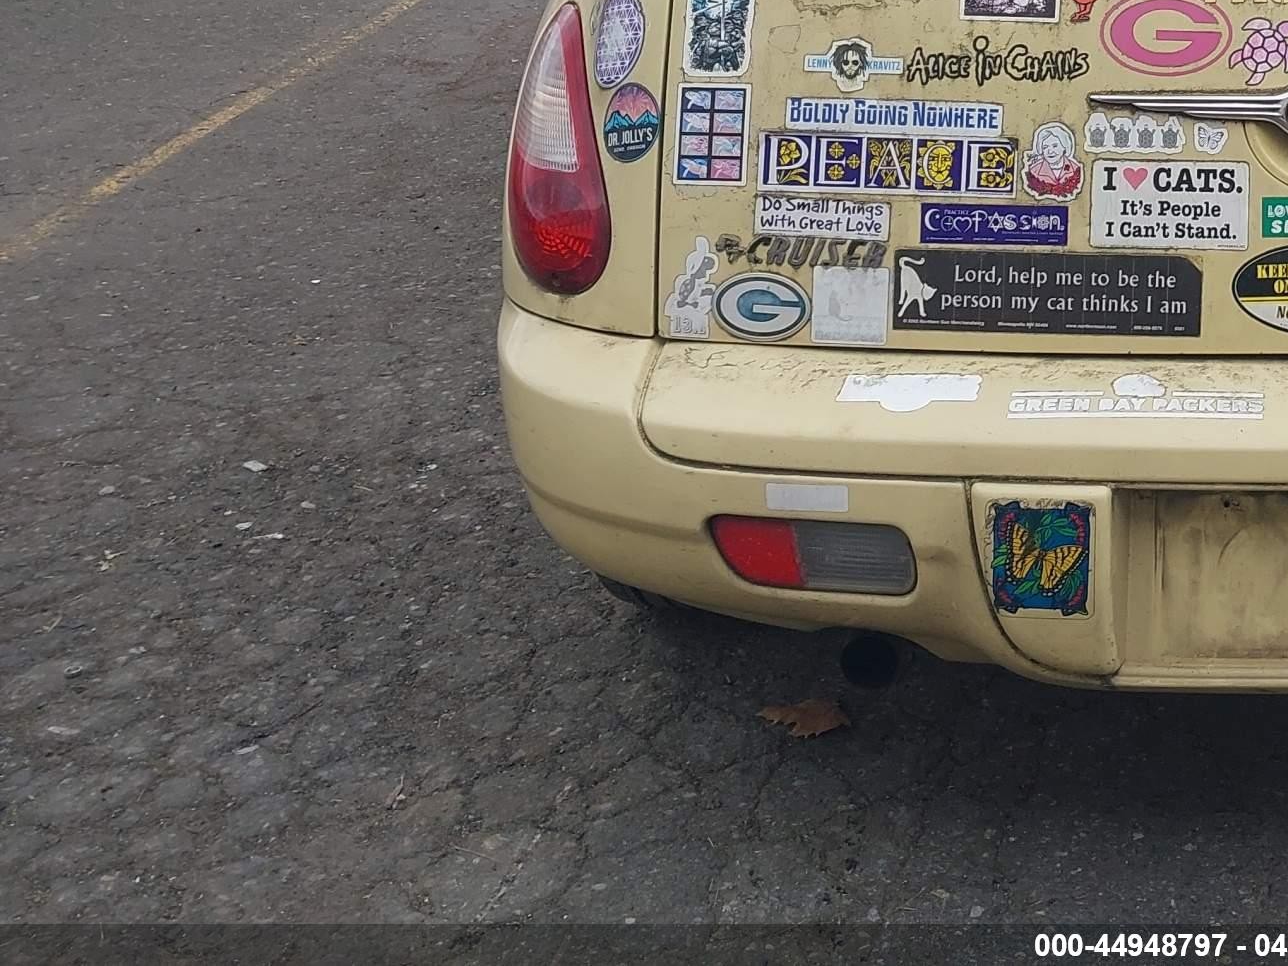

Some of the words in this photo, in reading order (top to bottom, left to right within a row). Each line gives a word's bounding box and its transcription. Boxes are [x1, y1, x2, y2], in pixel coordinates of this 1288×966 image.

[807, 58, 833, 69] LENNY
[867, 60, 901, 72] KRAVITZ
[789, 98, 850, 124] BOLDLY
[912, 101, 1000, 130] NOWHERE
[608, 133, 620, 147] DR.
[621, 127, 653, 145] JOLLY'S
[764, 134, 1013, 192] PEACE
[1102, 166, 1118, 191] I
[1152, 167, 1243, 194] CATS.
[761, 196, 783, 212] Do
[786, 197, 830, 215] Small
[832, 200, 884, 217] Things
[1120, 199, 1153, 216] It's
[1157, 200, 1221, 221] People
[760, 215, 796, 230] With
[799, 216, 842, 232] Great
[845, 217, 883, 235] Love
[1105, 221, 1115, 237] I
[1119, 221, 1170, 238] Can't
[1174, 222, 1237, 240] Stand.
[746, 234, 888, 270] CRUISER
[953, 265, 1002, 286] Lord,
[1008, 266, 1049, 289] help
[1054, 270, 1084, 285] me
[1091, 269, 1111, 286] to
[1117, 269, 1141, 287] be
[1147, 270, 1178, 289] the
[940, 292, 1002, 310] person
[1011, 295, 1040, 312] my
[1046, 294, 1075, 311] cat
[1081, 293, 1140, 313] thinks
[1146, 295, 1153, 314] I
[1159, 297, 1188, 315] am
[1008, 397, 1090, 412] GREEN
[1098, 397, 1147, 412] BAY
[1152, 398, 1265, 413] PACKERS
